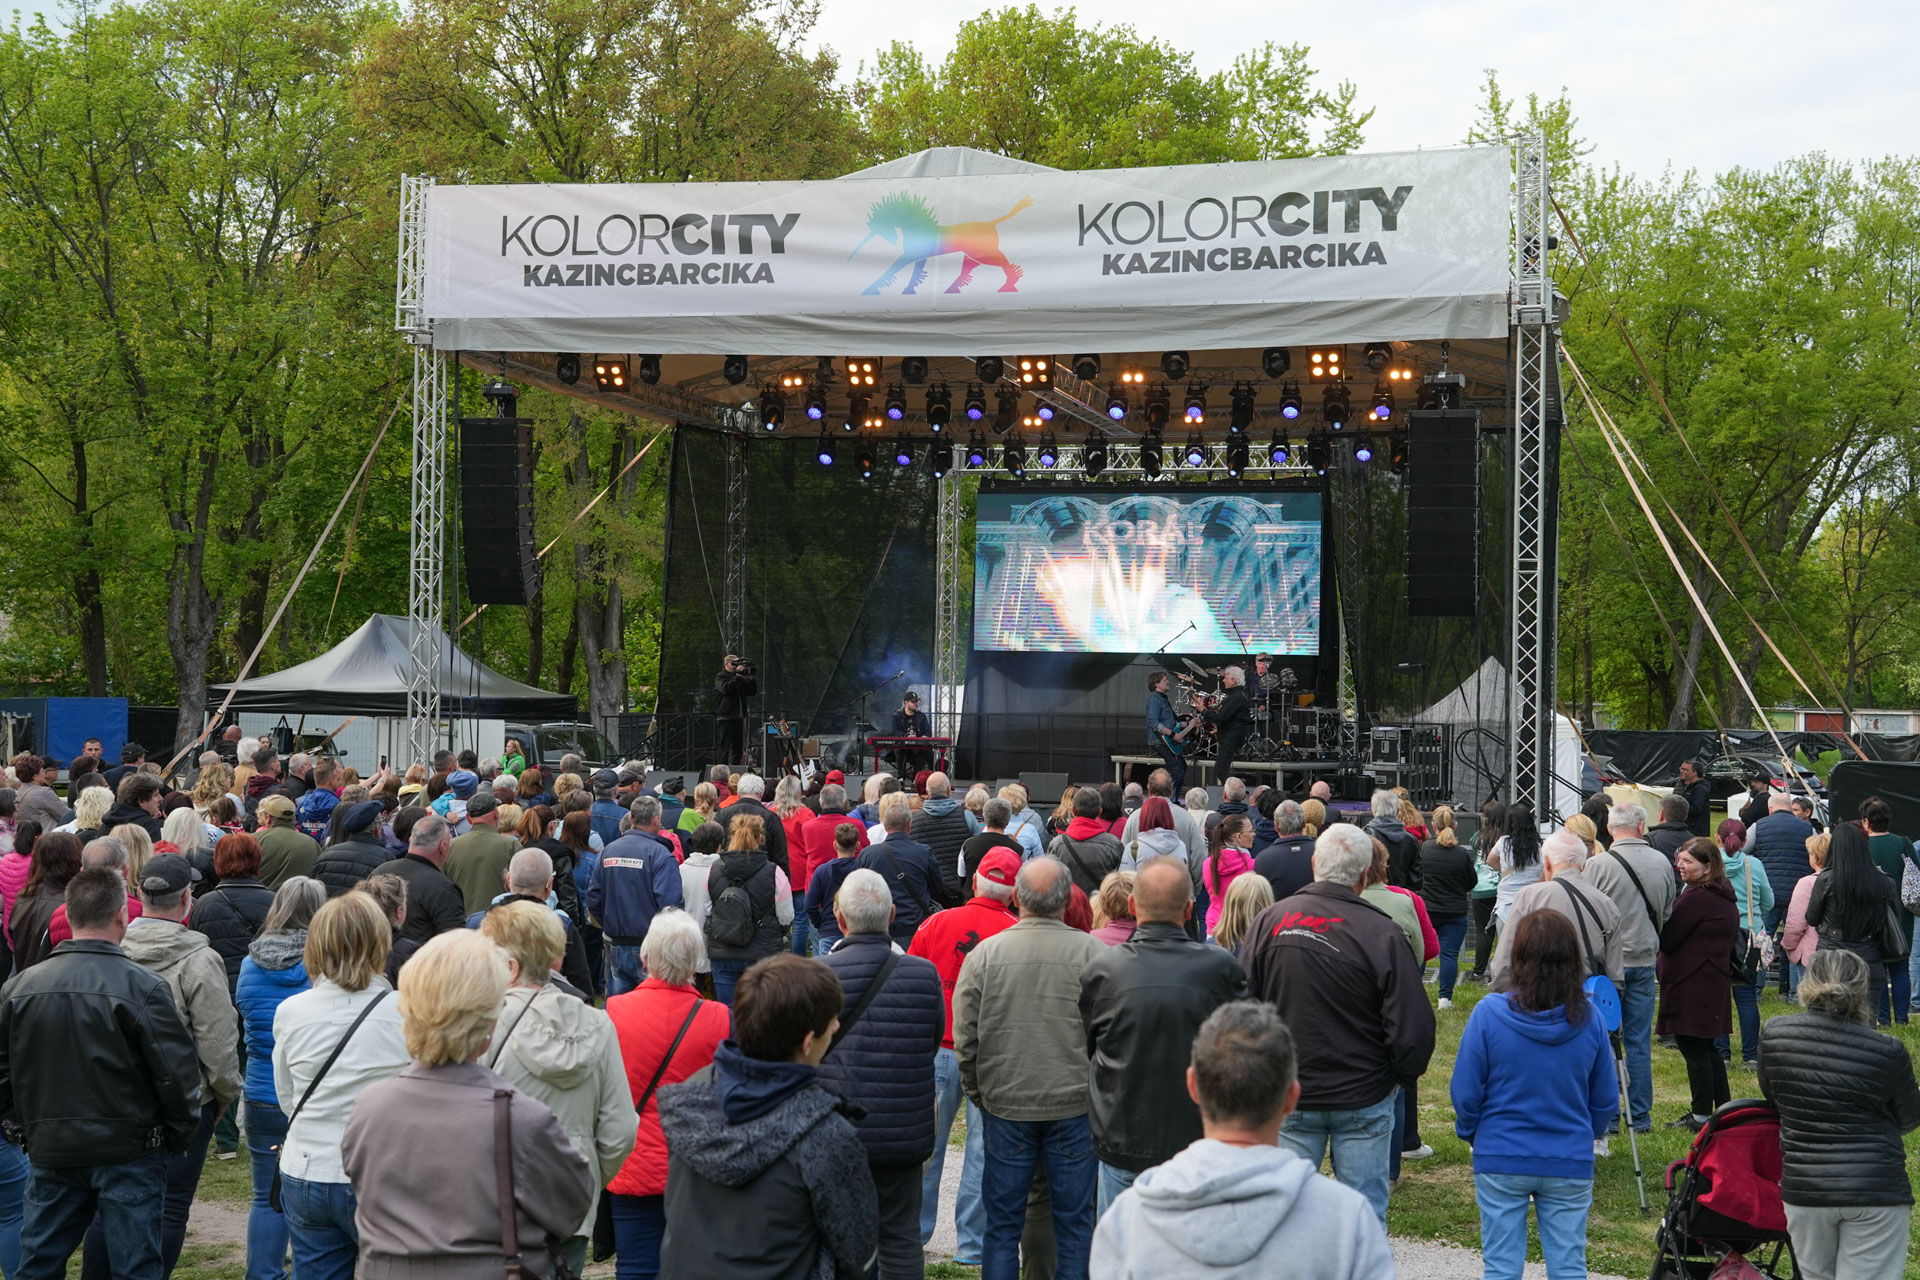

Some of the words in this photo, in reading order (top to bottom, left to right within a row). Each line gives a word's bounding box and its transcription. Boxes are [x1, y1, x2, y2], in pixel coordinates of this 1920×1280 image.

[501, 213, 801, 257] KOLORCITY
[1078, 185, 1414, 247] KOLORCITY
[523, 262, 775, 287] KAZINCBARCIKA
[1102, 241, 1387, 276] KAZINCBARCIKA
